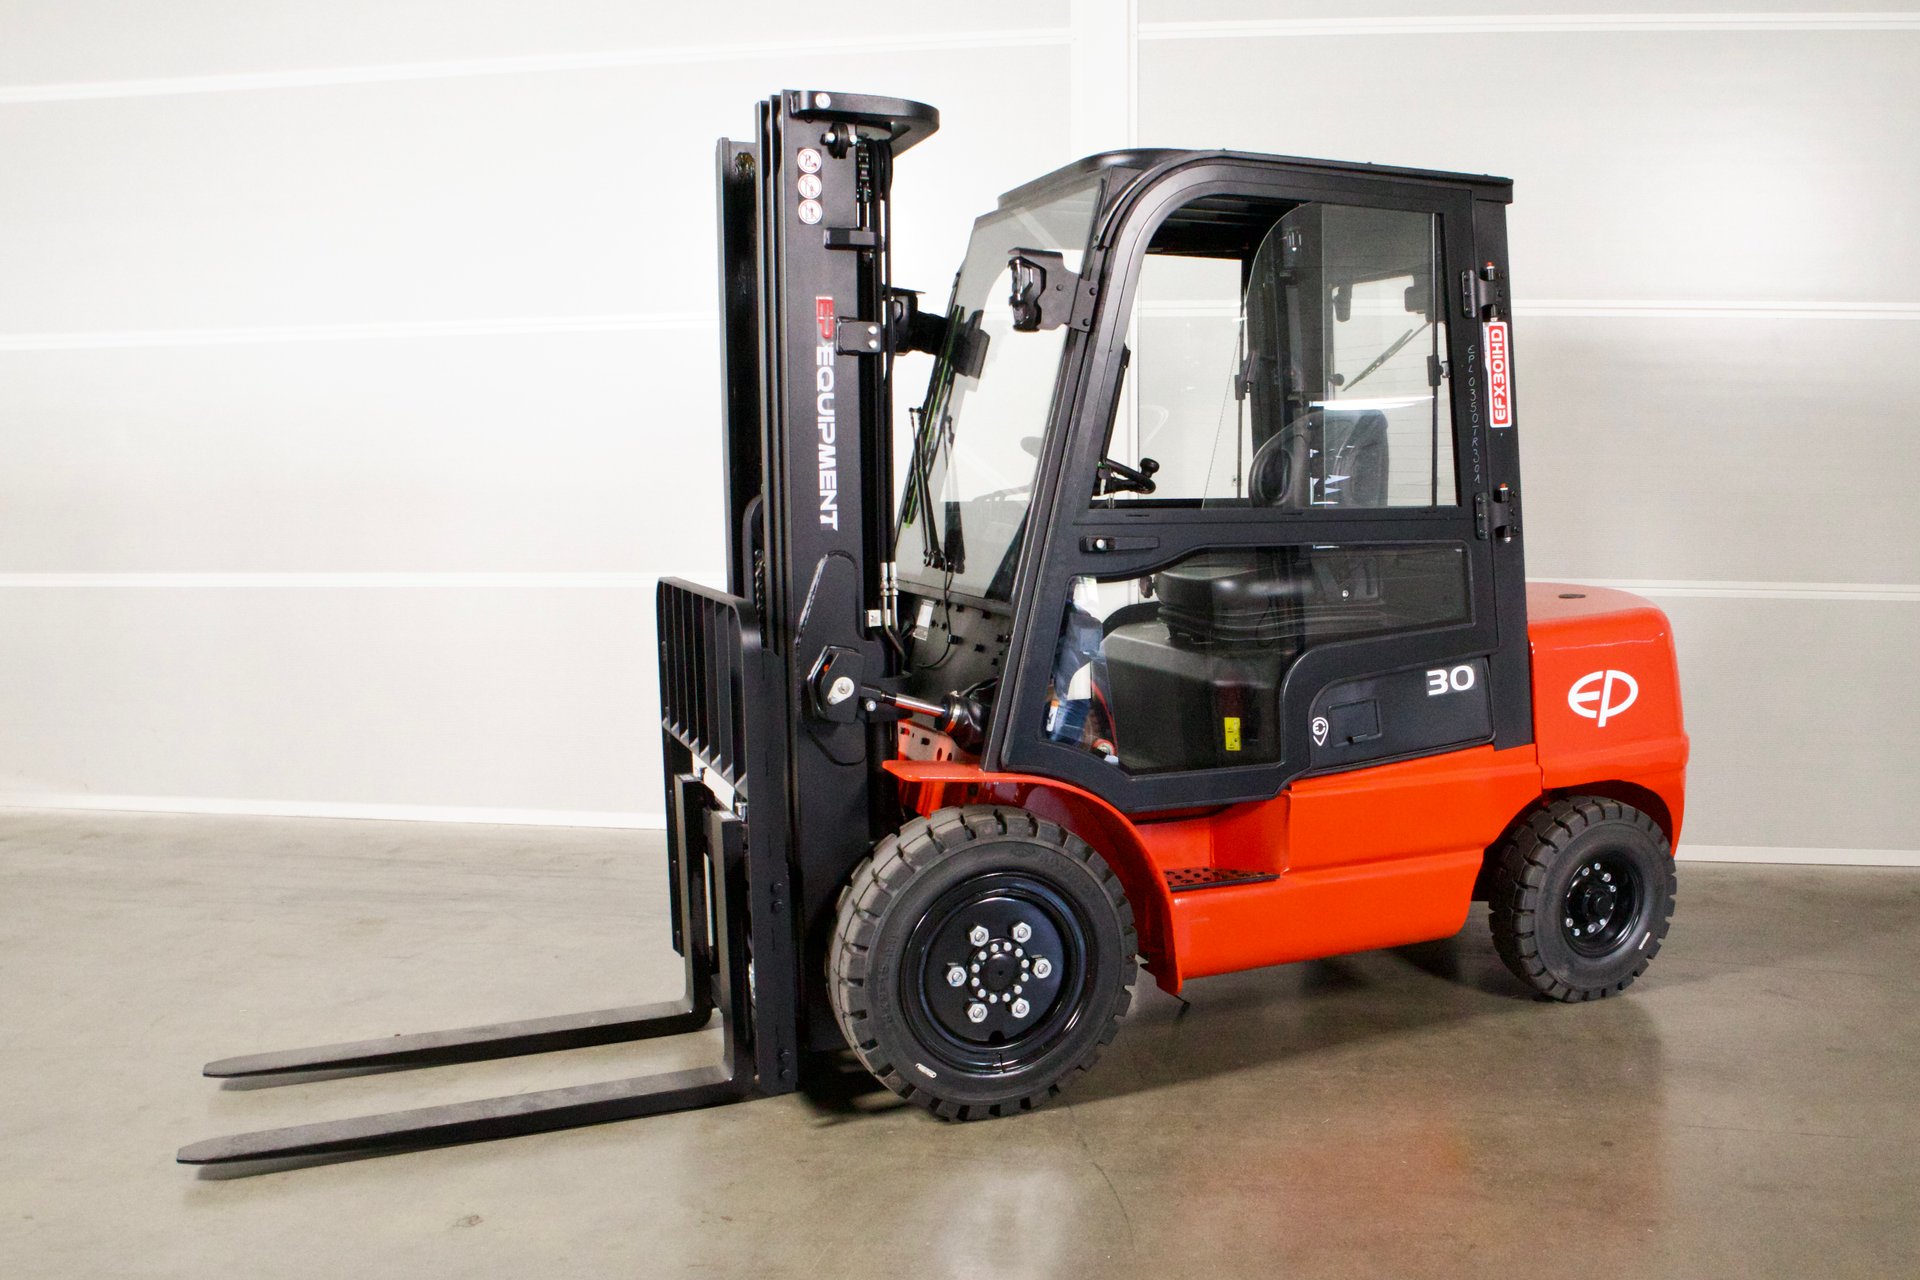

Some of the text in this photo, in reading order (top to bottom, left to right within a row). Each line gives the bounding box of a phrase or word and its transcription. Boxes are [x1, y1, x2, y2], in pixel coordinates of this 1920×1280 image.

[816, 296, 838, 531] EP EQUIPMENT
[1427, 664, 1474, 697] 30
[1568, 669, 1639, 728] EP
